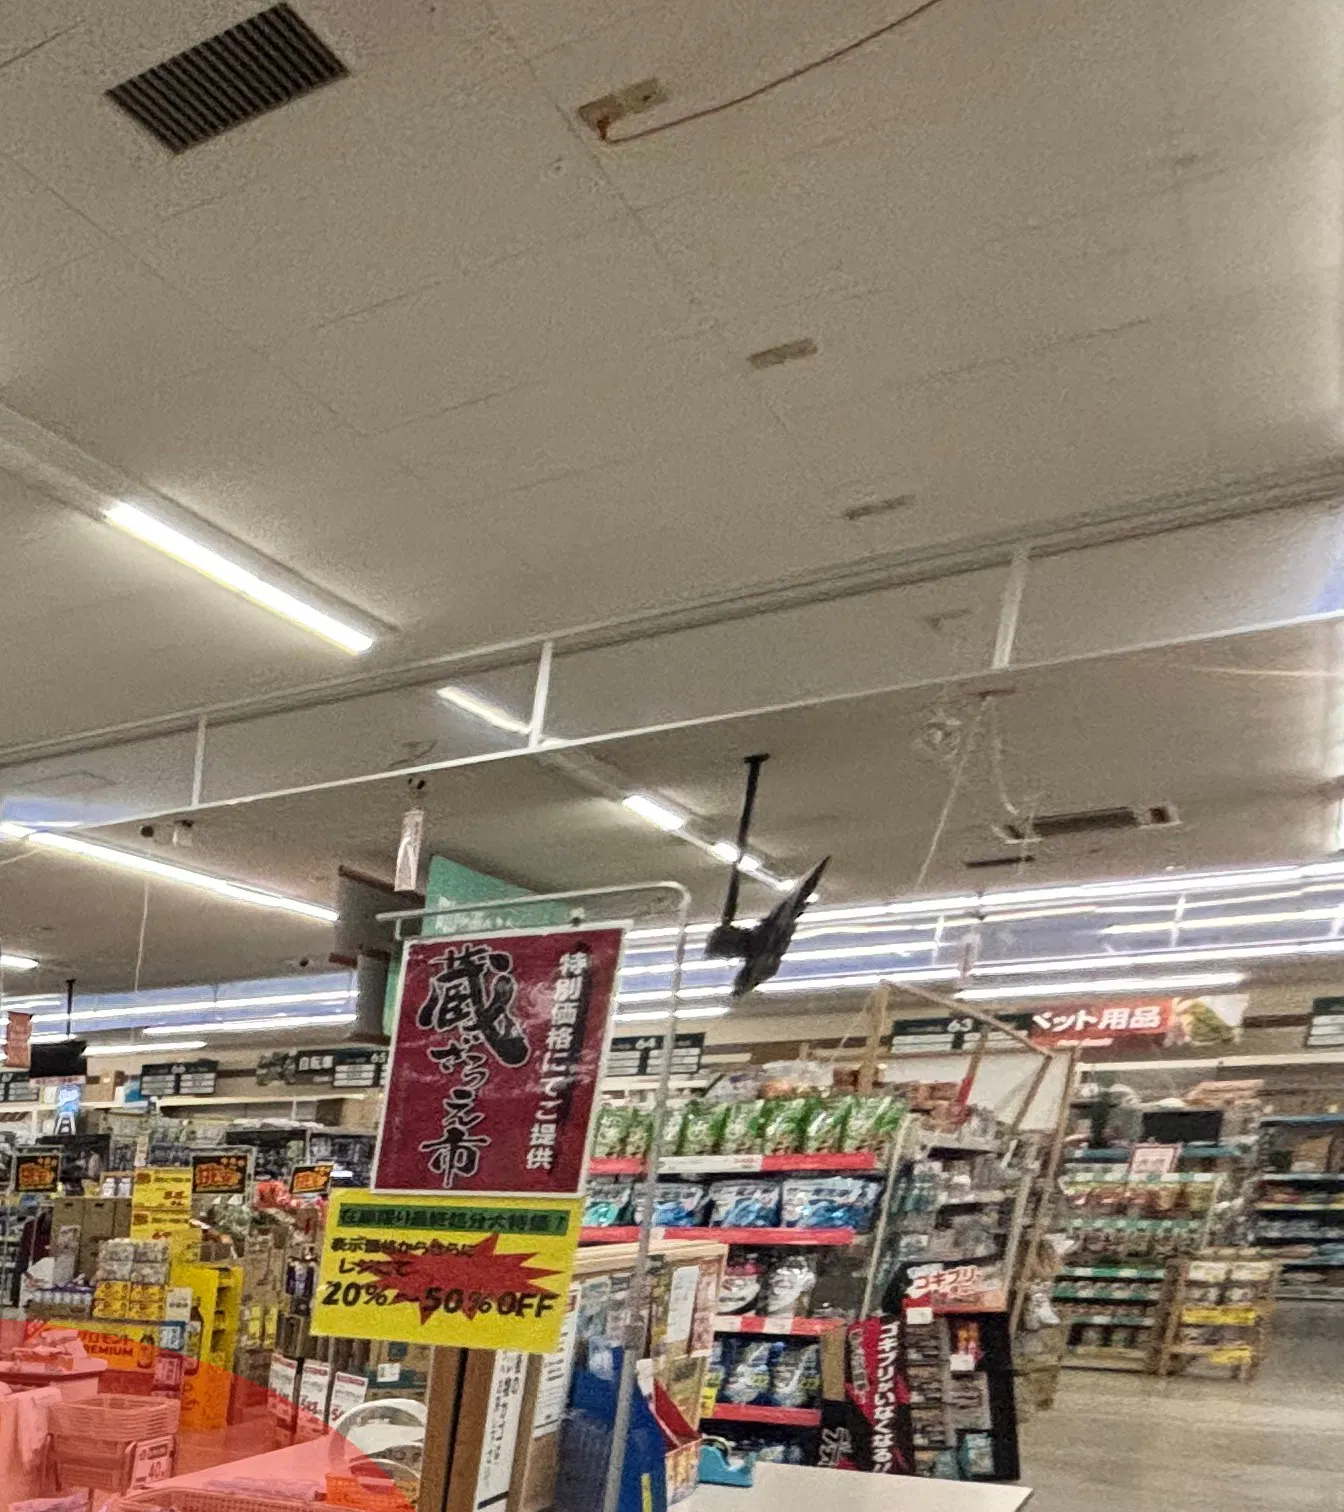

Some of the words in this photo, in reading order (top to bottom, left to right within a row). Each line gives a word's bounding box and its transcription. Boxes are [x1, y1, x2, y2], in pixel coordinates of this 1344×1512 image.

[525, 951, 589, 1171] 特別価格にてご提供
